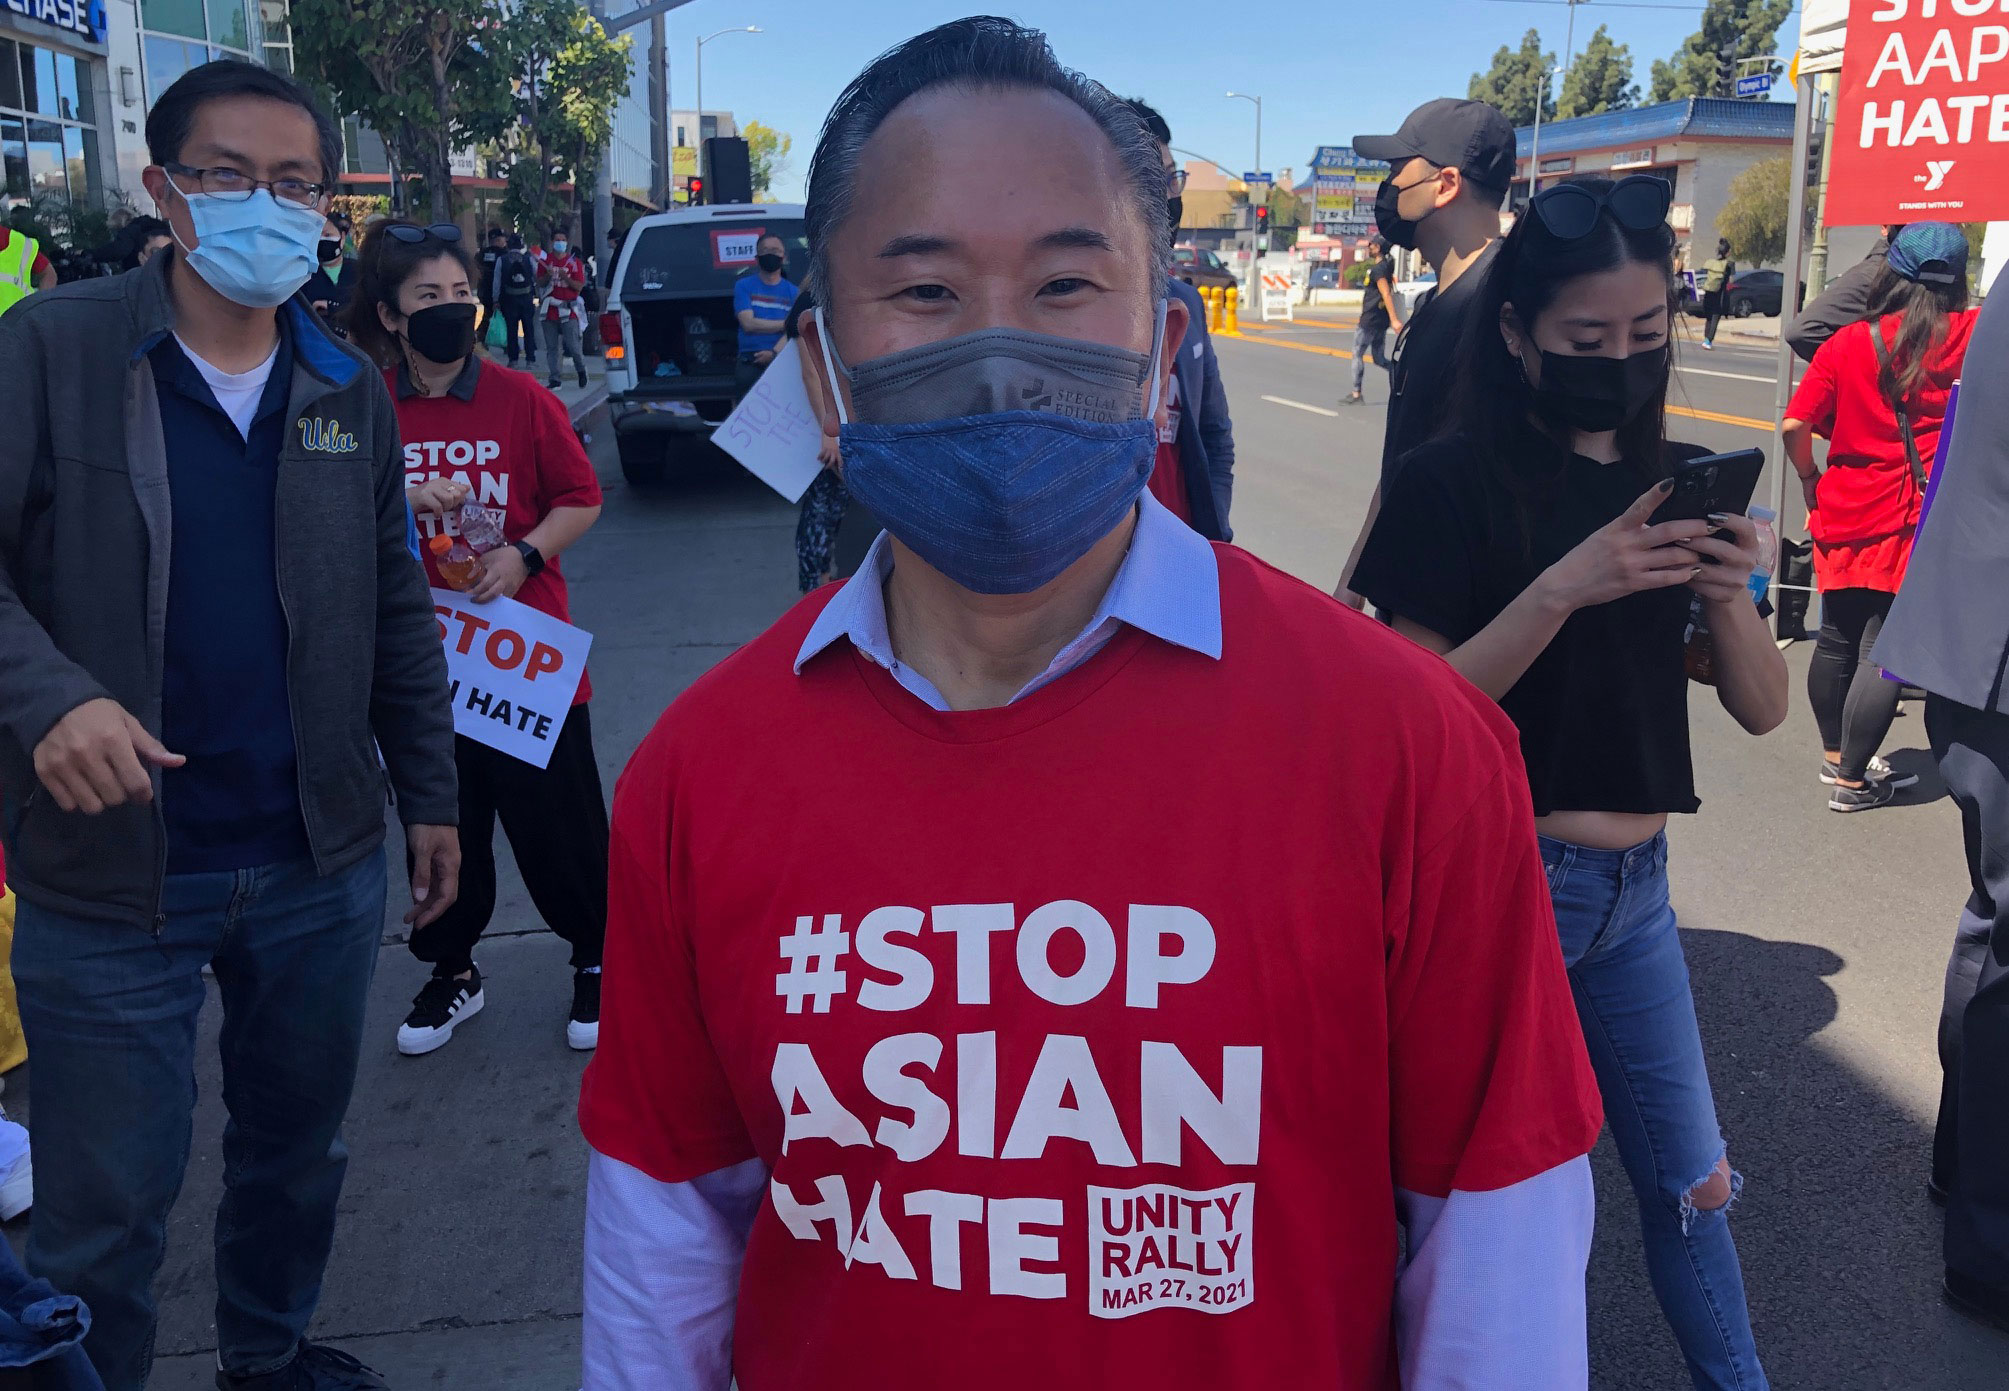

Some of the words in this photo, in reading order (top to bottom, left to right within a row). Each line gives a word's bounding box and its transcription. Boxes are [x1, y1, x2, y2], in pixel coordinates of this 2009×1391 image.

[1859, 94, 2009, 149] HATE
[1899, 202, 1927, 210] STANDS
[1928, 201, 1947, 209] WITH
[725, 244, 754, 256] STAFF
[728, 381, 781, 449] STOP
[1055, 403, 1114, 424] EDITION
[1057, 389, 1116, 410] SPECIAL
[466, 687, 553, 741] HATE
[775, 899, 1217, 1014] #STOP
[771, 1030, 1263, 1167] ASIAN
[771, 1174, 1067, 1300] HATE
[1101, 1191, 1242, 1237] UNITY
[1102, 1232, 1242, 1279] RALLY
[1102, 1282, 1154, 1310] MAR
[1159, 1278, 1192, 1302] 27,
[1198, 1278, 1246, 1306] 2021
